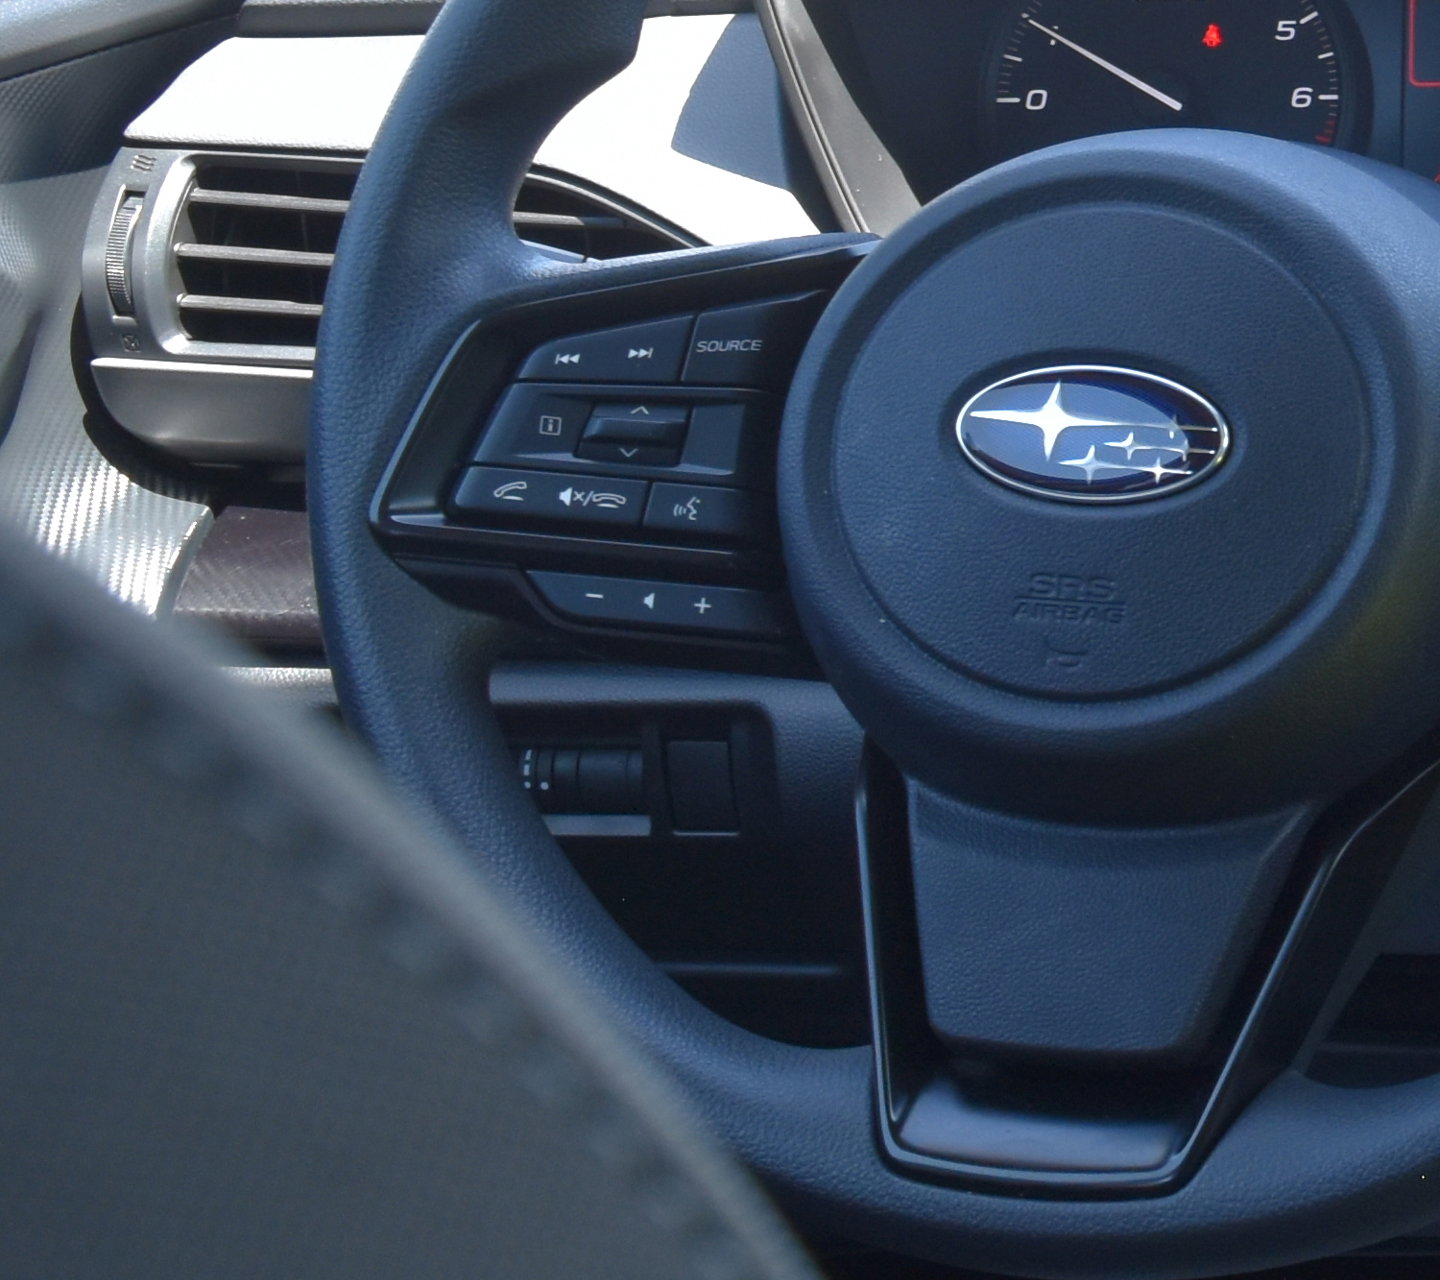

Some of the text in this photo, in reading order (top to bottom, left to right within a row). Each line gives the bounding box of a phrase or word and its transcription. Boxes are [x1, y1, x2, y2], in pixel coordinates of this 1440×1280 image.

[1275, 20, 1297, 41] 5
[1025, 89, 1048, 111] 0
[1291, 87, 1313, 108] 6
[695, 339, 763, 353] SOURCE
[1028, 572, 1118, 600] SRS
[1012, 601, 1126, 624] AIRBAG
